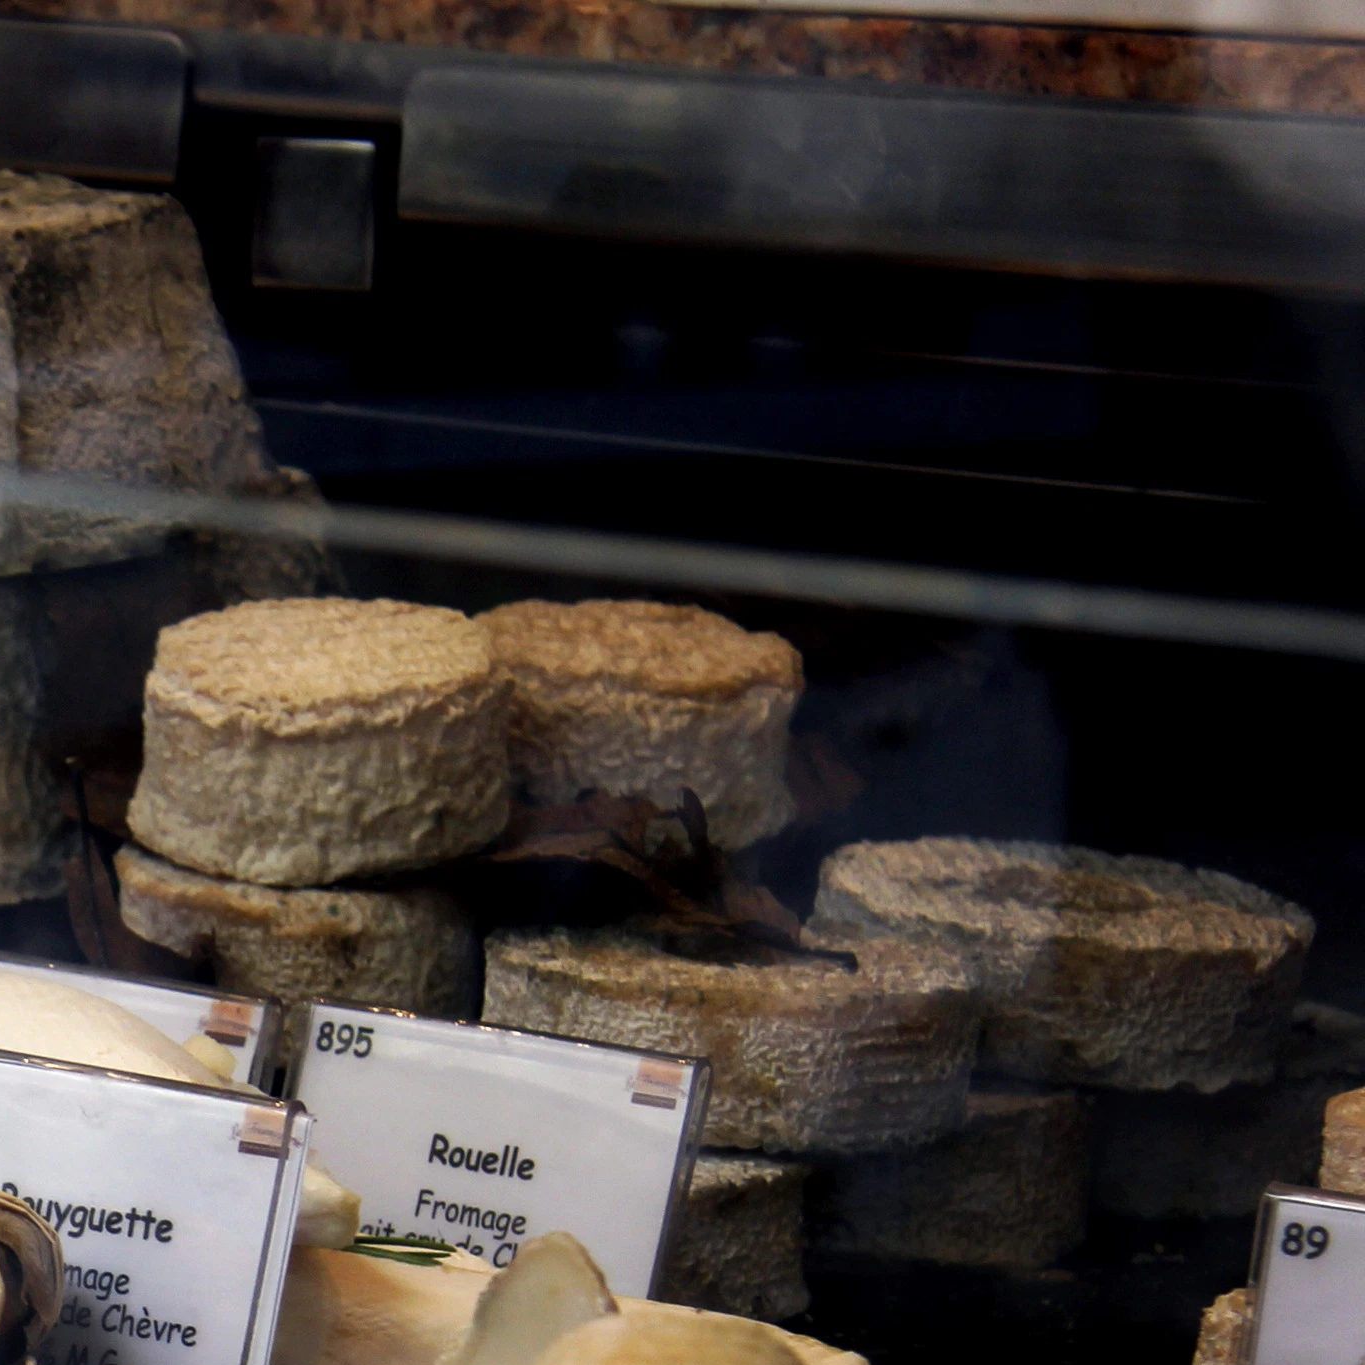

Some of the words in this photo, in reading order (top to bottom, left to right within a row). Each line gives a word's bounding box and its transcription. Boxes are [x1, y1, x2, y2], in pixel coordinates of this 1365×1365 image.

[315, 1021, 374, 1058] 895
[428, 1132, 535, 1180] Rouelle
[415, 1189, 526, 1240] Fromage
[1281, 1222, 1330, 1259] 89
[101, 1305, 197, 1347] Chèvre
